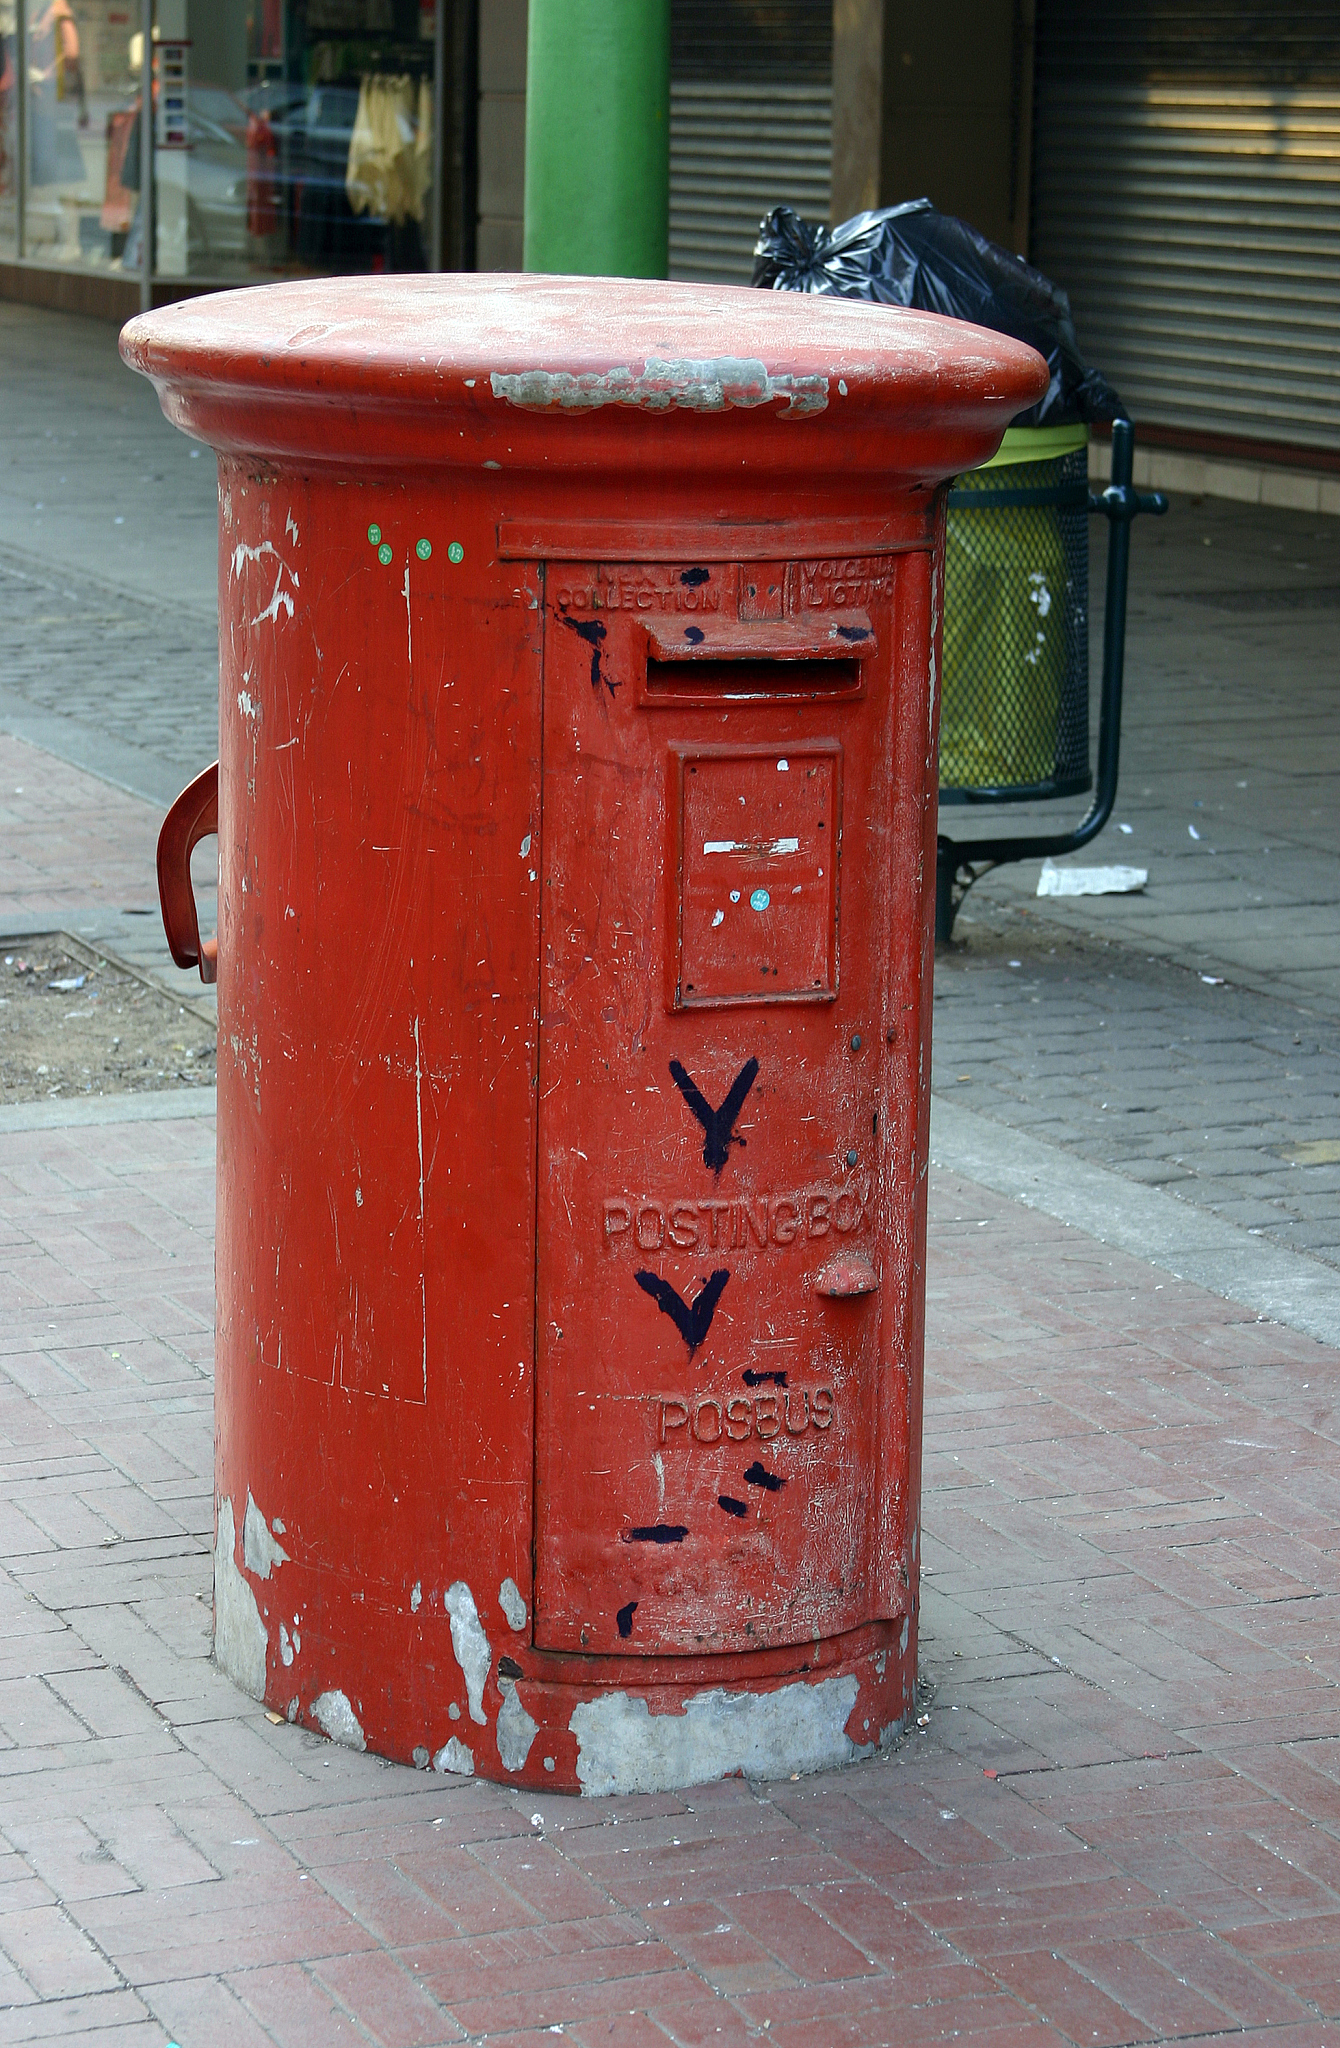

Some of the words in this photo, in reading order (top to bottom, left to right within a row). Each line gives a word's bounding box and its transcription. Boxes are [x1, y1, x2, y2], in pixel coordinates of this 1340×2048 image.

[555, 587, 721, 611] COLLECTION
[602, 1199, 799, 1251] POSTING
[657, 1386, 835, 1443] POSBUS
